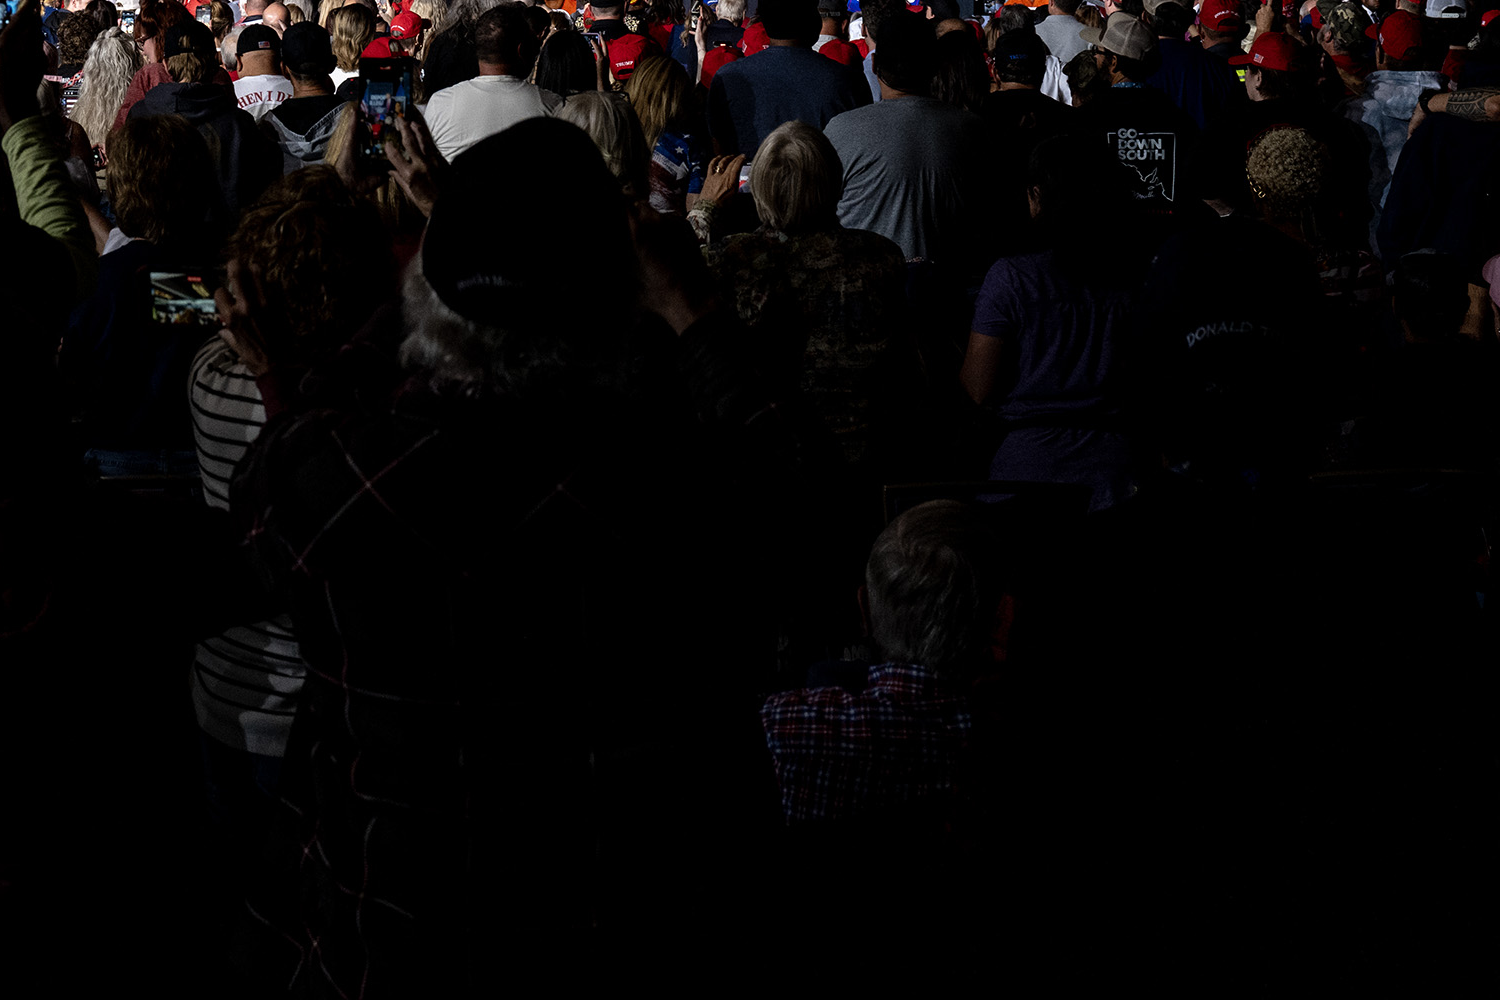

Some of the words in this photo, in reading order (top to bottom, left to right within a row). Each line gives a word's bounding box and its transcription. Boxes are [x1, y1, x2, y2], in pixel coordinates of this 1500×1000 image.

[1117, 128, 1137, 139] GO
[1118, 138, 1162, 150] DOWN
[1118, 149, 1165, 160] SOUTH
[1186, 320, 1254, 348] DONALD
